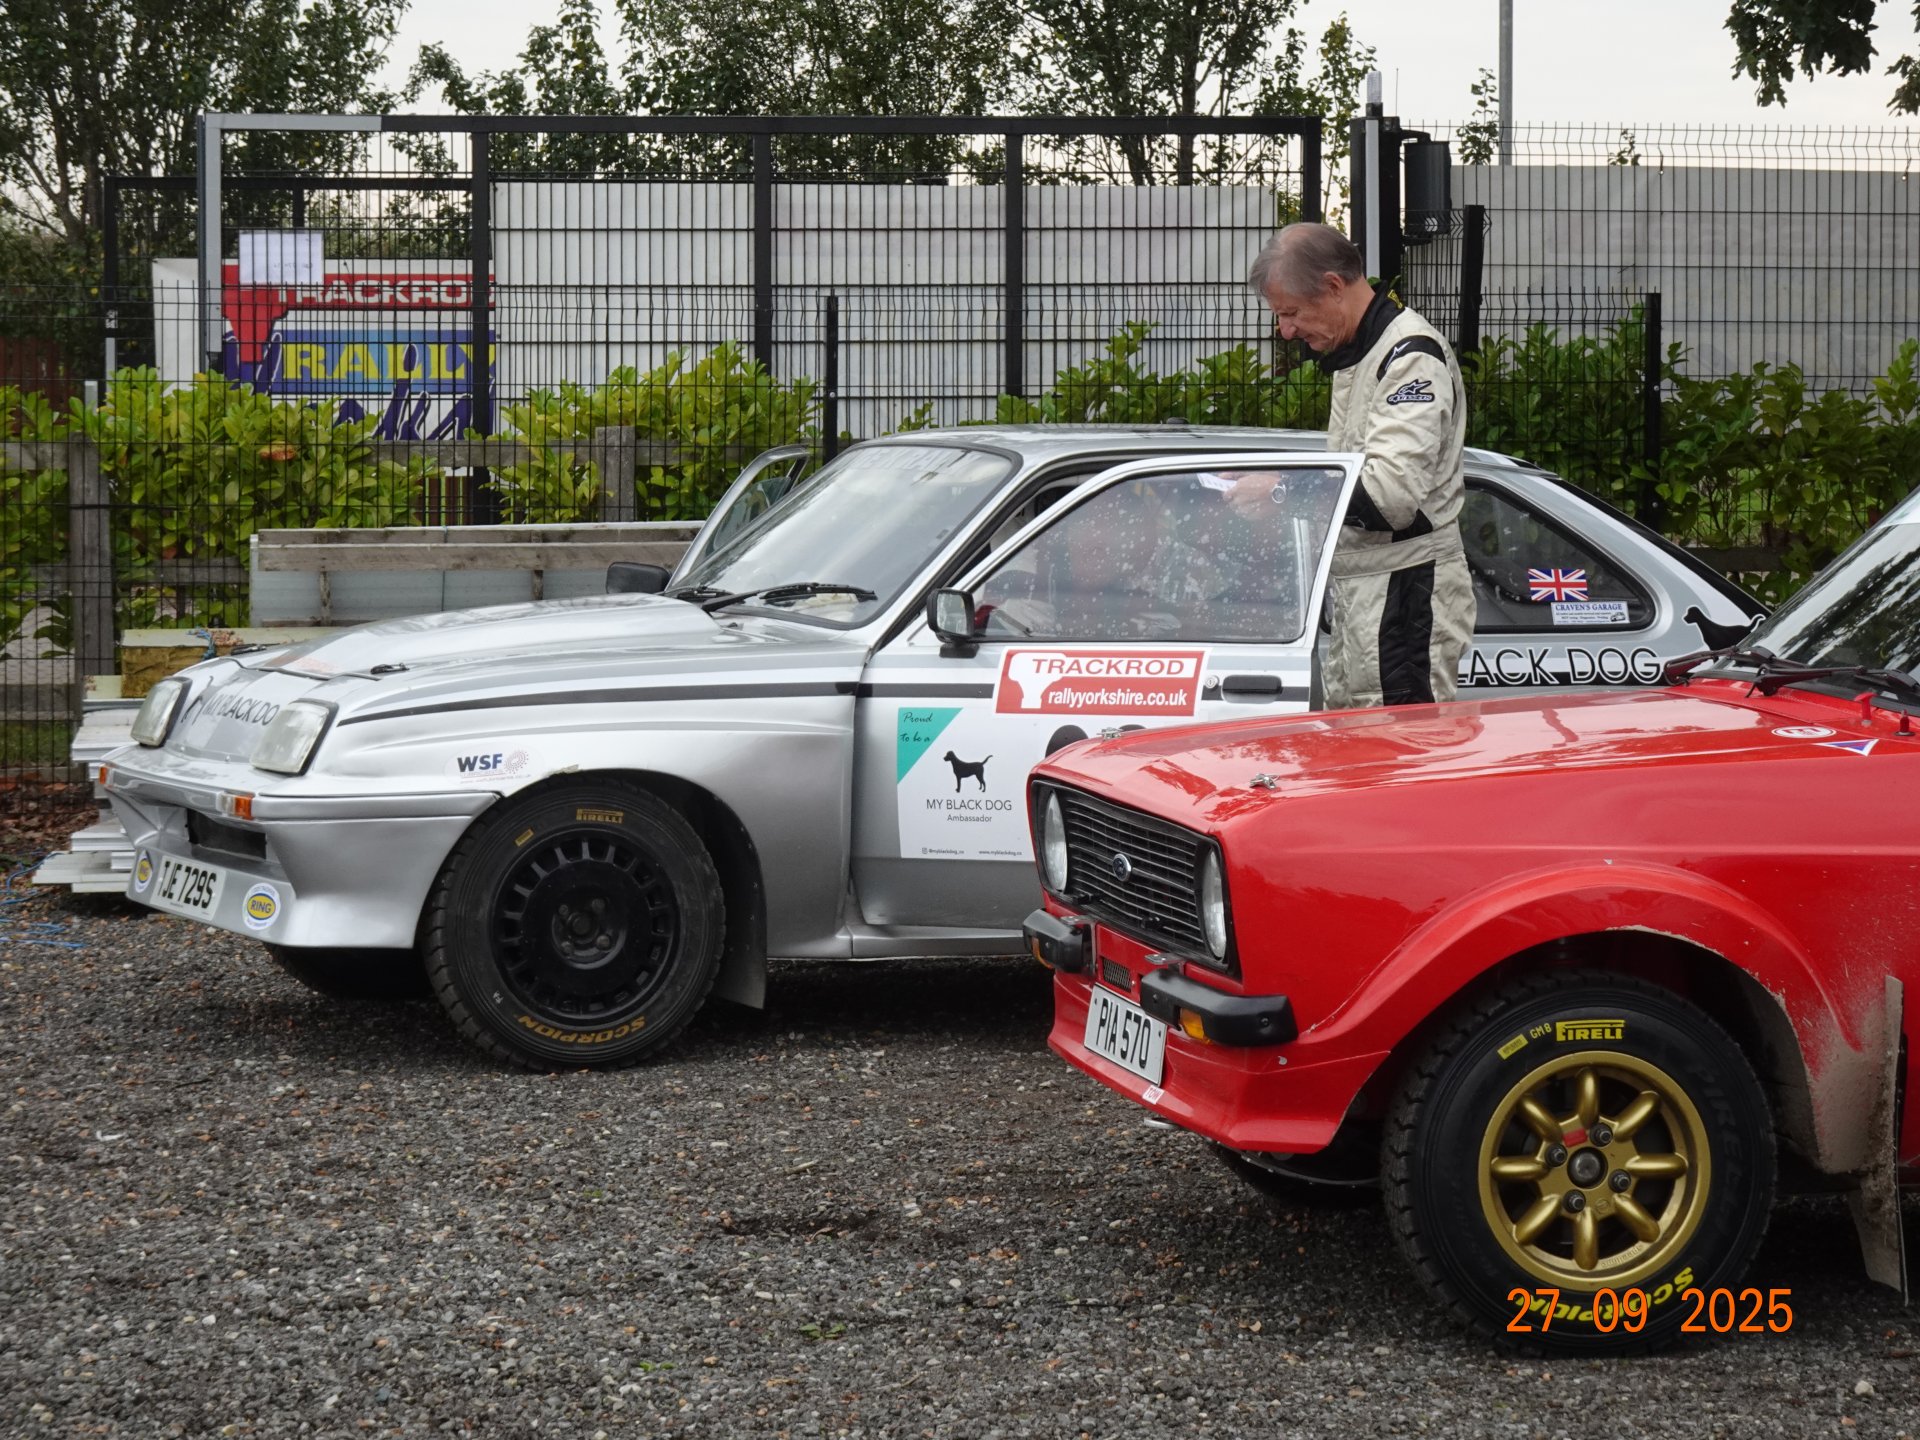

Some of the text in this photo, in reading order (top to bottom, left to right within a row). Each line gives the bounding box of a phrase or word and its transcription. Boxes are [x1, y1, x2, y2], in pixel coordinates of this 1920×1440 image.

[1032, 658, 1185, 675] TRACKROD
[1567, 647, 1661, 684] DOG
[1048, 687, 1188, 708] rallyyorkshire.co.uk
[217, 693, 262, 722] BLACK
[251, 701, 280, 727] DO
[903, 711, 934, 723] Proud
[457, 753, 503, 772] WSF
[926, 799, 1012, 811] MY BLACK DOG
[576, 808, 625, 824] PIRELLI
[947, 814, 993, 823] Ambassador
[177, 866, 217, 909] 729S
[250, 899, 272, 914] RING
[517, 1015, 647, 1043] SCORPION
[1095, 997, 1152, 1069] PIA 570
